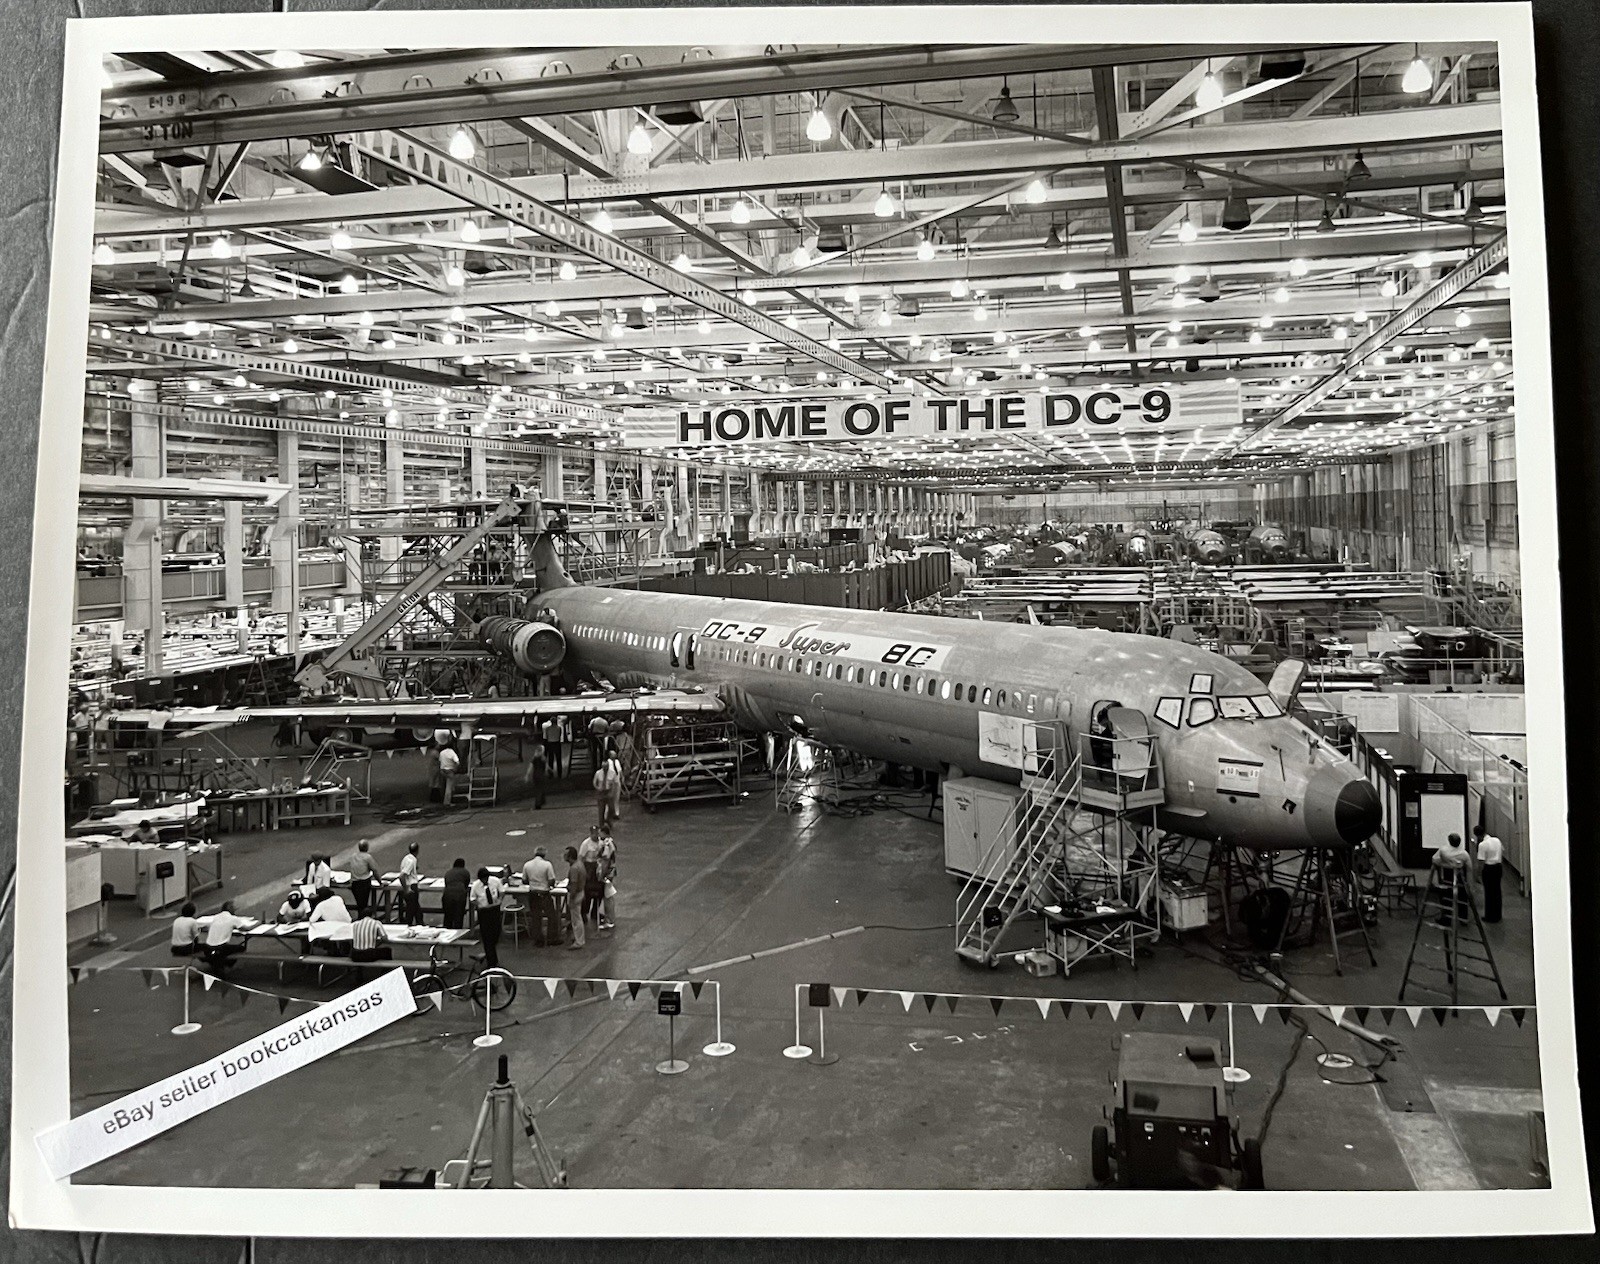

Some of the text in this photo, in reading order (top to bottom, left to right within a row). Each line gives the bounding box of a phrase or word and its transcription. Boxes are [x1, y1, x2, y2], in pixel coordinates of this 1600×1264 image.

[161, 121, 193, 140] TON
[679, 390, 1172, 442] HOME OF THE DC-9
[397, 591, 421, 614] GALION
[701, 621, 768, 644] DC-9
[779, 623, 852, 655] Super
